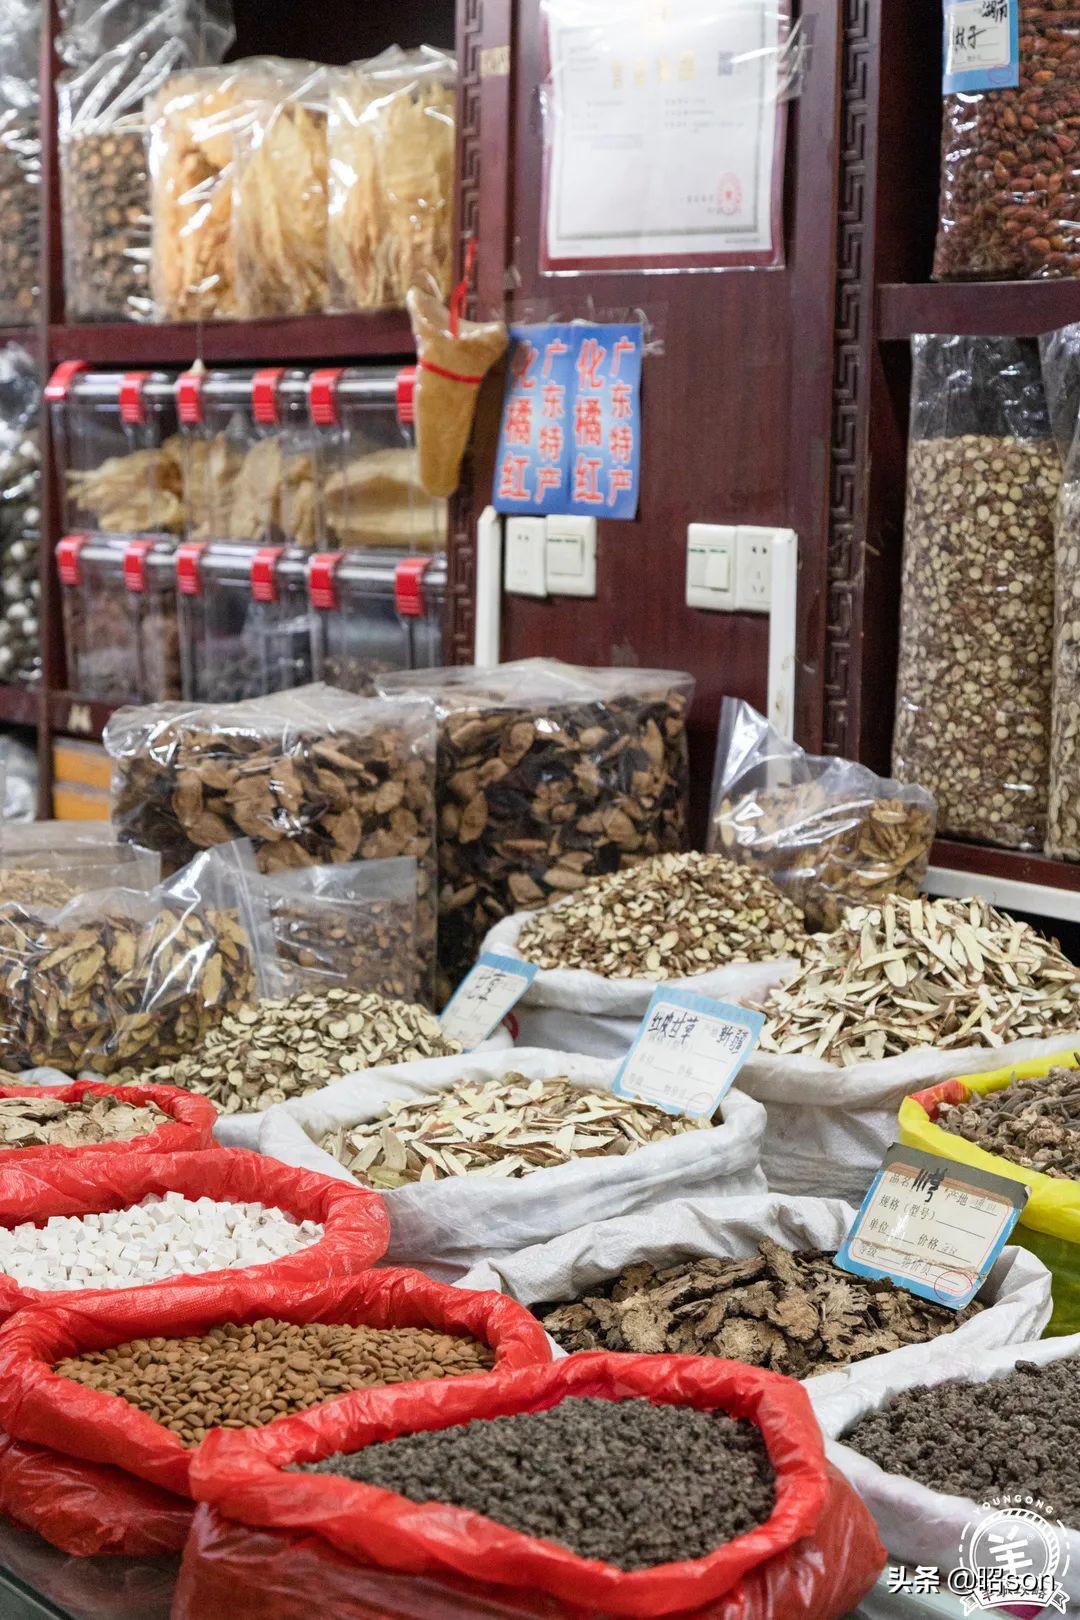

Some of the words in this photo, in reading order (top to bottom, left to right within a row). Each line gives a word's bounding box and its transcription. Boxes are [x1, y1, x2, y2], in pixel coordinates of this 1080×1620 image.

[534, 337, 569, 505] 广东特产
[608, 335, 636, 507] 广东特产
[868, 1217, 889, 1236] 单位
[916, 1232, 939, 1252] 价格
